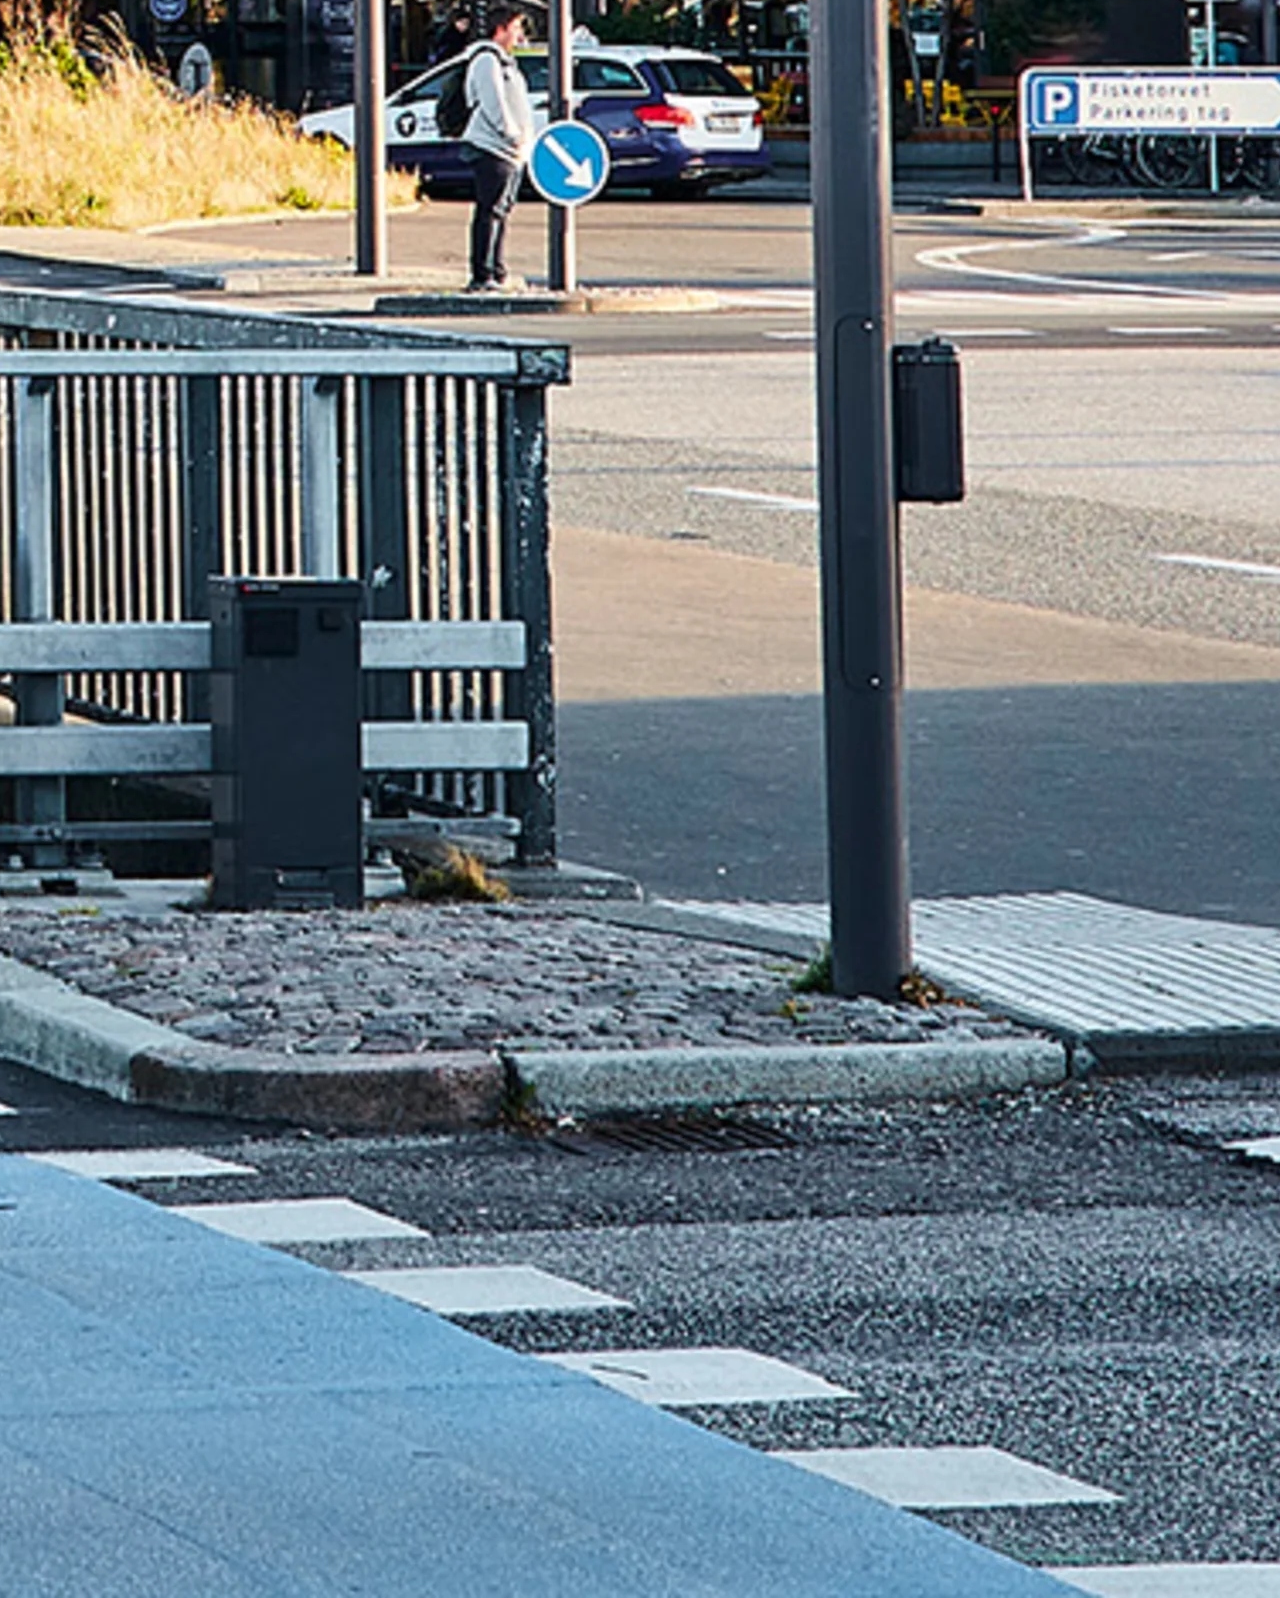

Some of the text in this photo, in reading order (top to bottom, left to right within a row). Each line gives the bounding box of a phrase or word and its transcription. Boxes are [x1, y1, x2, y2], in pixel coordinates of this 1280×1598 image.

[1089, 83, 1211, 98] Fisketorvet
[1044, 86, 1072, 122] P
[1089, 103, 1188, 122] Parkering
